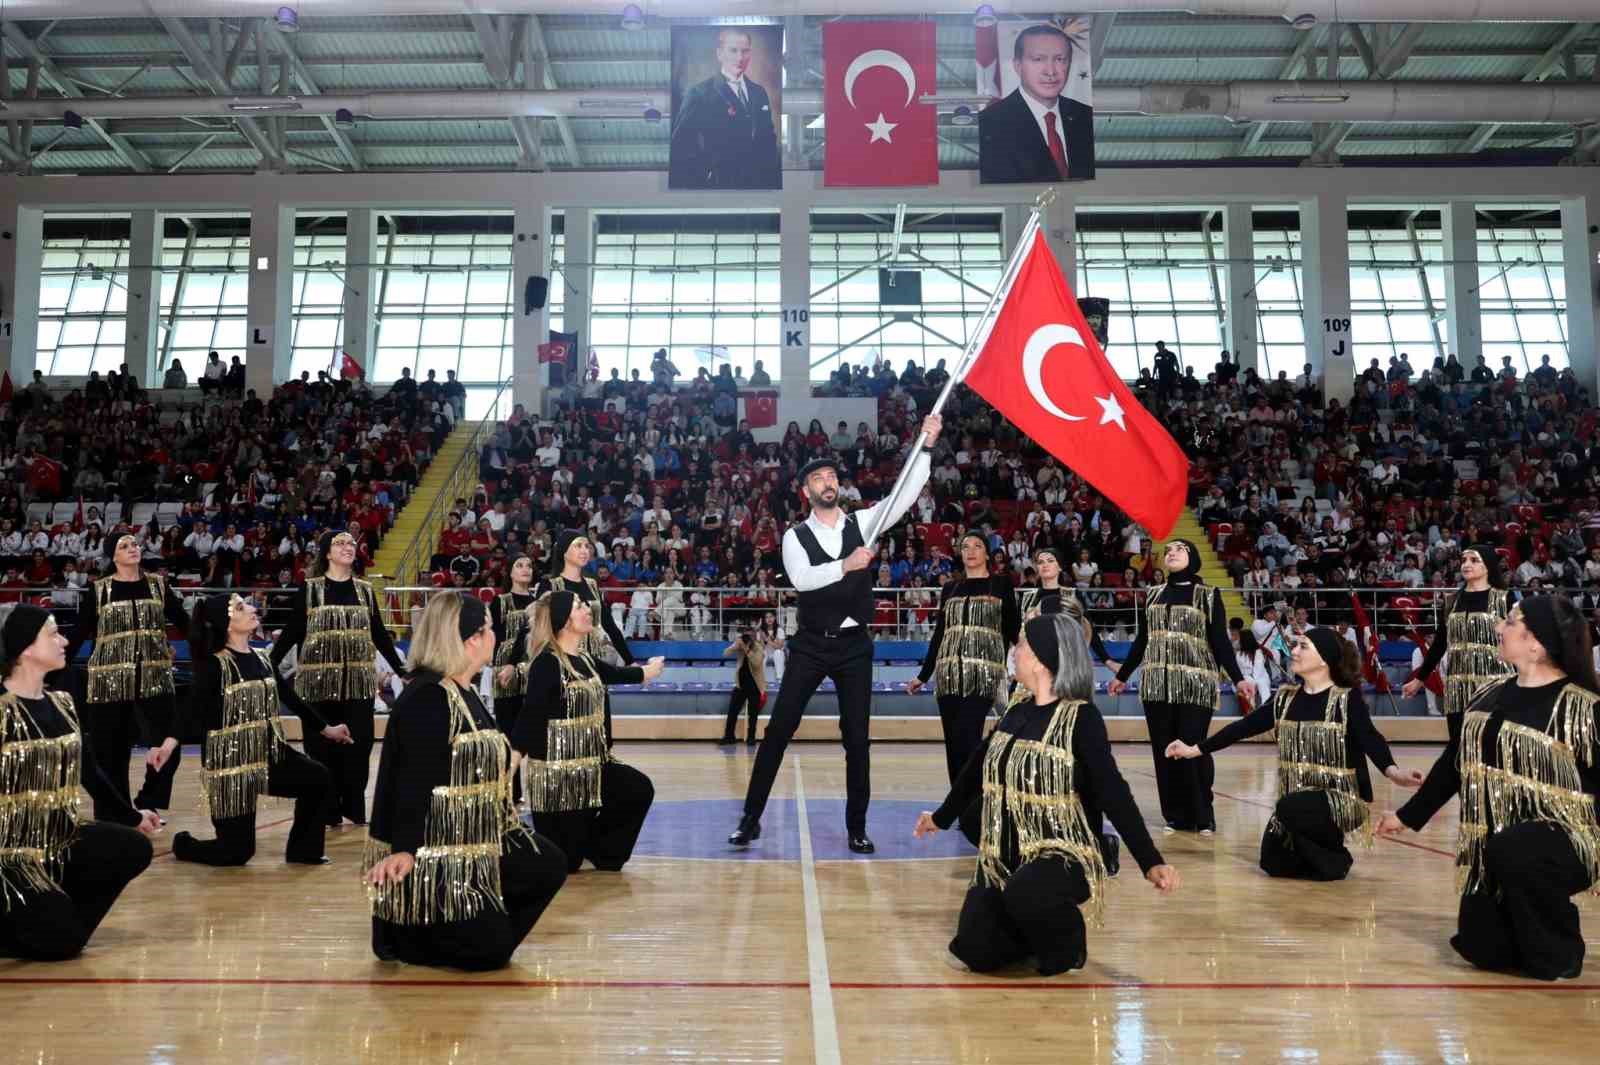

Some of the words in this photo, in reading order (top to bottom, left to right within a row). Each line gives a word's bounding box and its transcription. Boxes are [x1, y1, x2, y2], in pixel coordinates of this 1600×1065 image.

[783, 310, 808, 323] 110
[1323, 318, 1351, 332] 109
[254, 329, 266, 344] L
[786, 331, 802, 346] K
[1332, 340, 1345, 356] J
